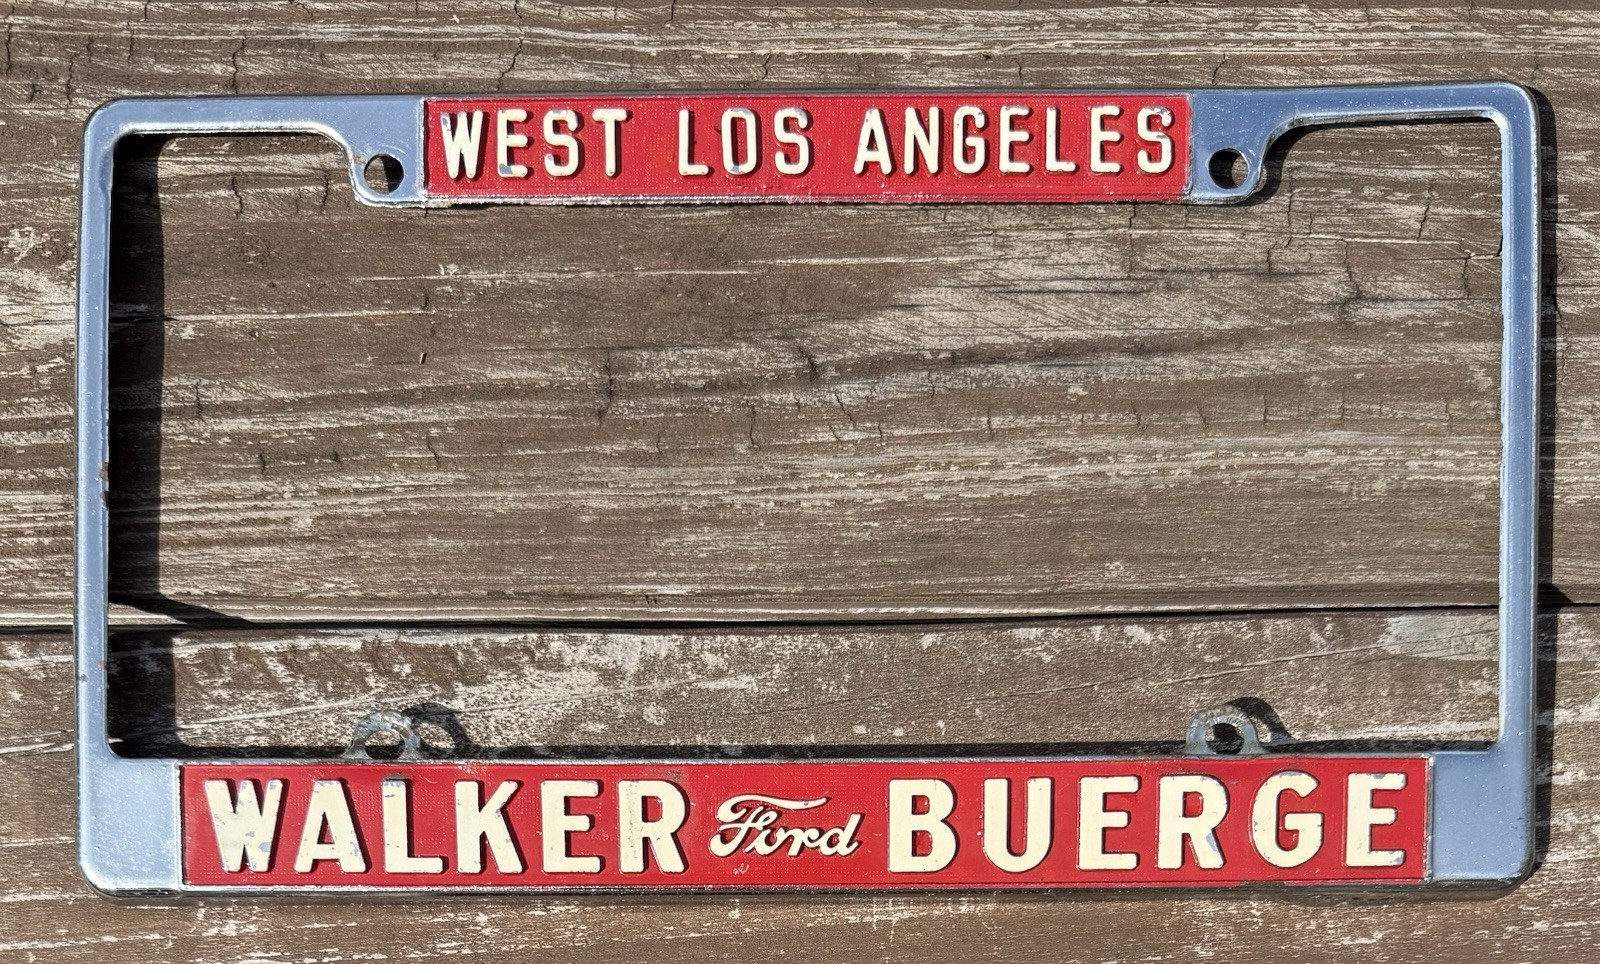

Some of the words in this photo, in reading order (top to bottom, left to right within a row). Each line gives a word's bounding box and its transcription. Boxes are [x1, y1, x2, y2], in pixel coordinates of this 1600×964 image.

[441, 107, 627, 179] WEST
[679, 106, 810, 176] LOS
[854, 105, 1173, 175] ANGELES
[204, 779, 686, 874] WALKER
[709, 794, 862, 857] Ford
[888, 772, 1406, 873] BUERGE
